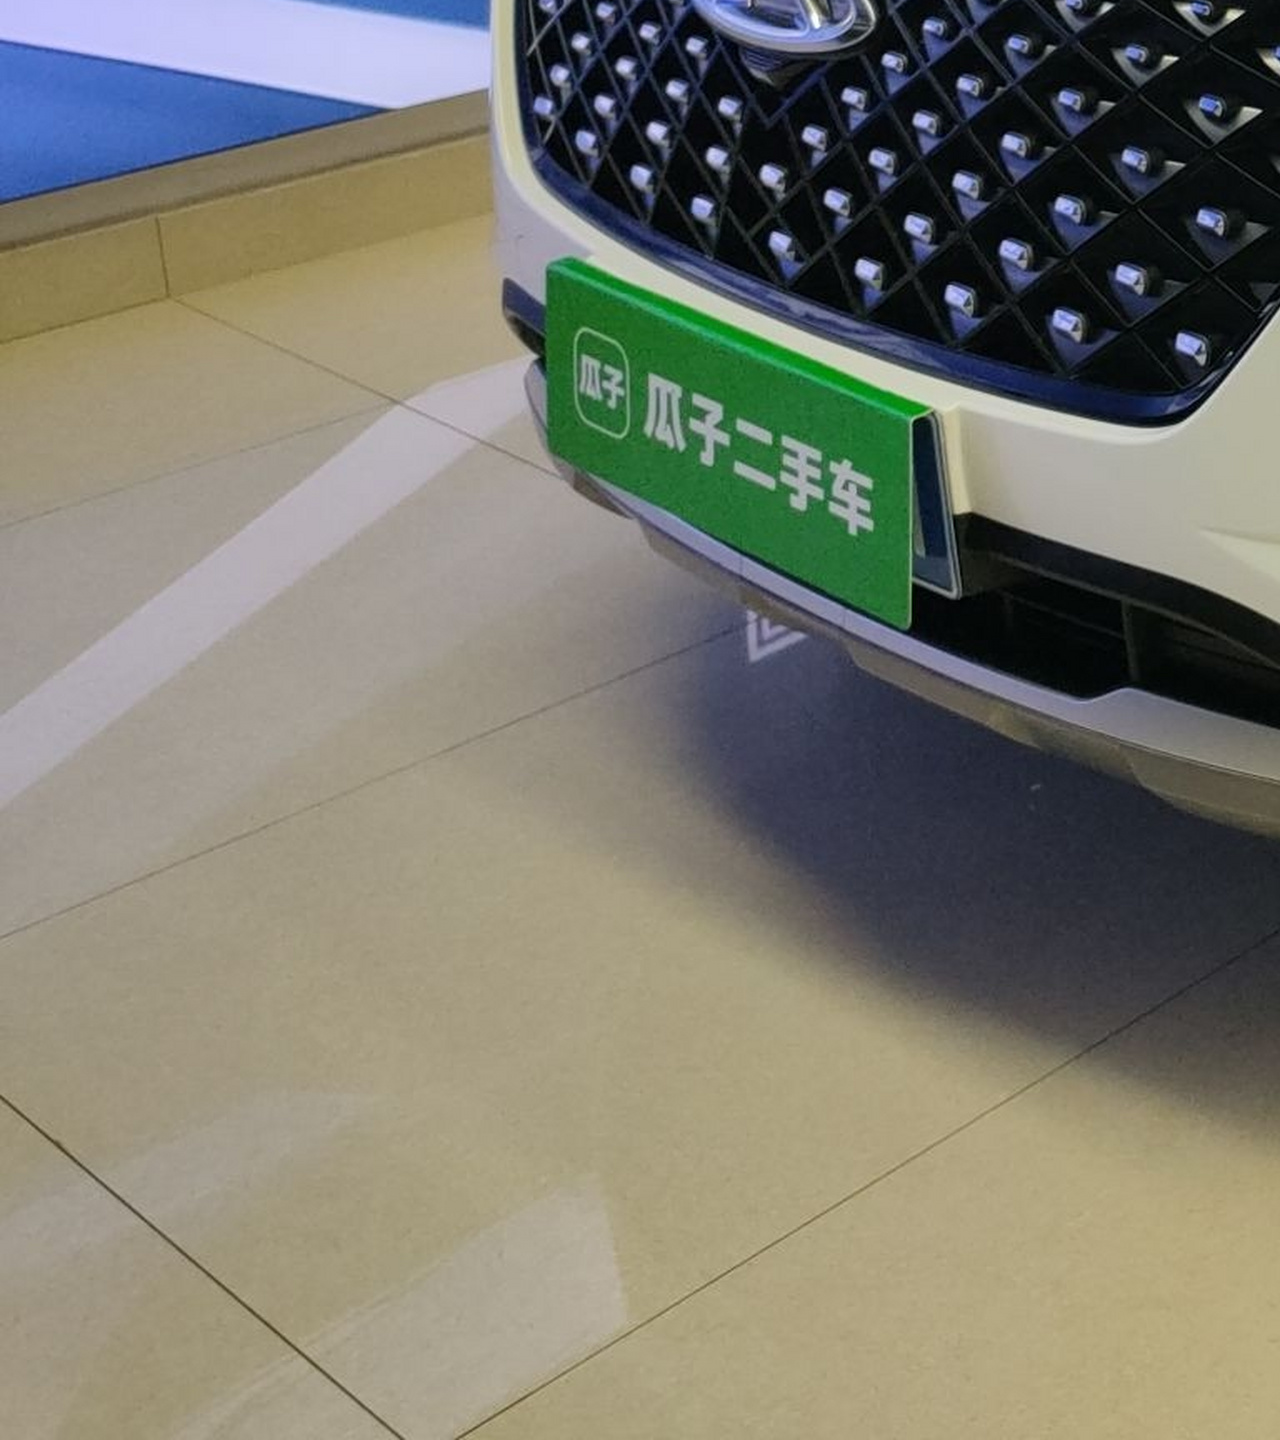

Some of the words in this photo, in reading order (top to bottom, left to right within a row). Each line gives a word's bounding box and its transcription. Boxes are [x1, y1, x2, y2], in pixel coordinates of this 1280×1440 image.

[580, 354, 625, 410] 瓜子
[643, 372, 874, 536] 瓜子二手车
